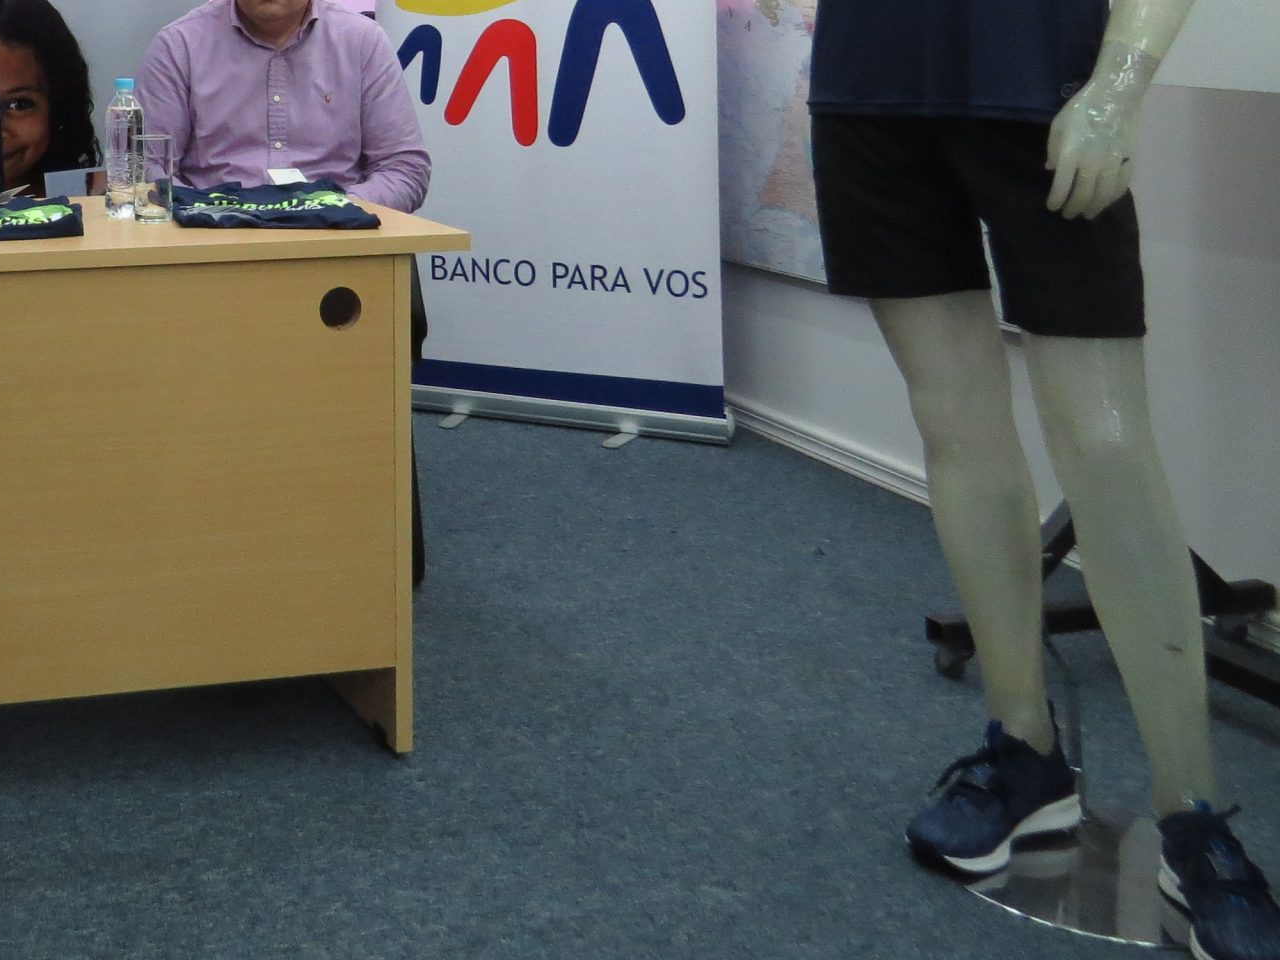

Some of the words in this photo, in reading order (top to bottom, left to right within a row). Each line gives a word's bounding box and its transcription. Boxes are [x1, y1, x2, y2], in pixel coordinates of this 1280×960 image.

[431, 255, 536, 287] BANCO
[552, 262, 631, 293] PARA
[643, 268, 708, 299] VOS
